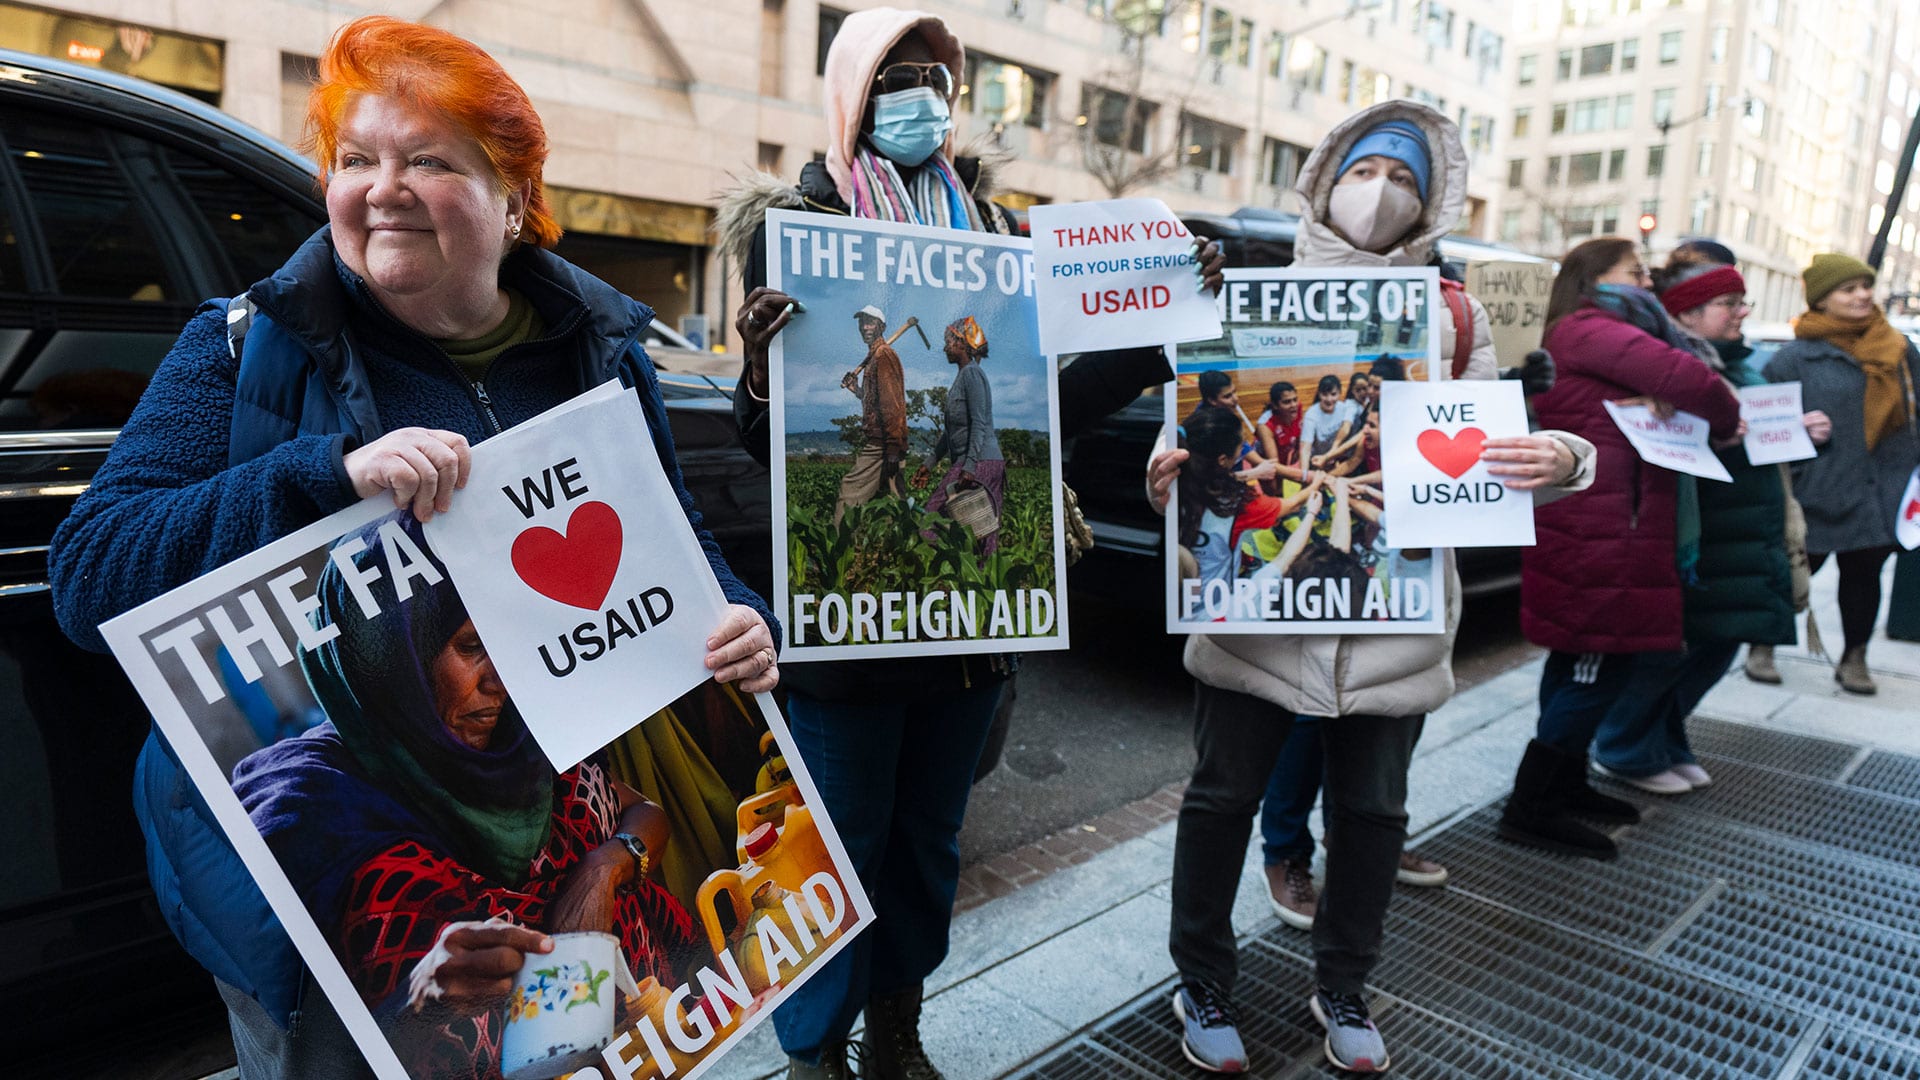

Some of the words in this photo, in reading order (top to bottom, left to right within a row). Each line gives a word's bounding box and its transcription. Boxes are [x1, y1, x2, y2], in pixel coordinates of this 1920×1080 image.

[1053, 223, 1135, 248] THANK
[1141, 220, 1187, 239] YOU
[783, 228, 864, 280] THE
[876, 237, 987, 292] FACES
[996, 251, 1037, 297] OF
[1052, 263, 1083, 278] FOR
[1087, 258, 1130, 275] YOUR
[1134, 254, 1196, 270] SERVICE
[1081, 285, 1171, 316] USAID
[1261, 281, 1370, 322] FACES
[1378, 281, 1424, 322] OF
[1482, 301, 1519, 327] SAID
[1260, 336, 1297, 346] USAID
[1427, 403, 1476, 423] WE
[501, 457, 589, 519] WE
[1412, 482, 1504, 504] USAID
[793, 590, 977, 644] FOREIGN
[989, 588, 1055, 637] AID
[1182, 577, 1351, 620] FOREIGN
[1361, 577, 1431, 620] AID
[150, 566, 342, 705] THE
[537, 586, 674, 678] USAID
[755, 871, 846, 986] AID
